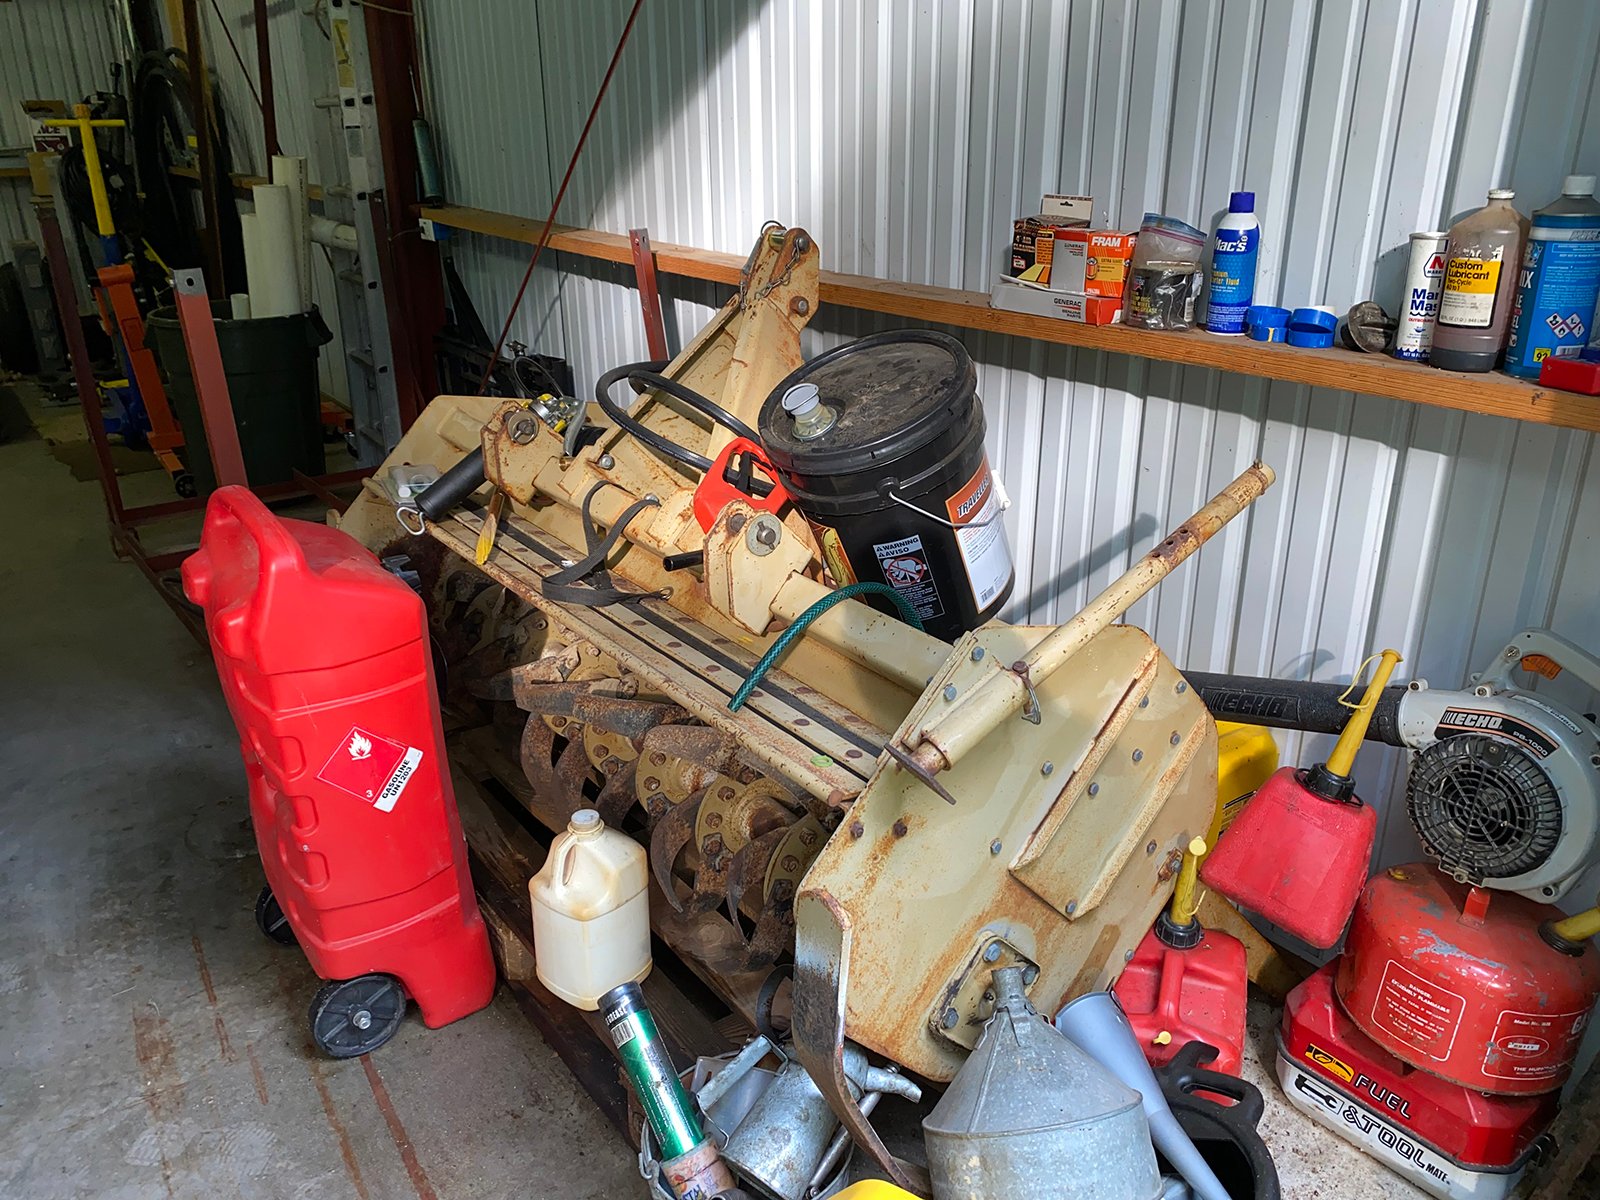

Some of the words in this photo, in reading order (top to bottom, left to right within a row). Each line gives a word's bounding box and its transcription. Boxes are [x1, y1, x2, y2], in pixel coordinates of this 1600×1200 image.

[1091, 236, 1121, 248] FRAM
[1449, 259, 1483, 271] Custom
[1448, 268, 1490, 280] Lubricant
[1447, 278, 1472, 287] Two-Cycle
[1053, 297, 1082, 307] GENERAC
[882, 537, 919, 551] WARNING
[885, 546, 910, 557] AVISO
[1454, 713, 1502, 730] ECHO
[1513, 730, 1549, 757] PB-1000
[381, 758, 410, 799] GASOLINE
[365, 789, 373, 798] 3
[1391, 978, 1417, 998] EXTREMELY
[1417, 995, 1451, 1014] FLAMMABLE
[1354, 1074, 1412, 1120] FUEL
[1425, 1163, 1448, 1183] MATE
